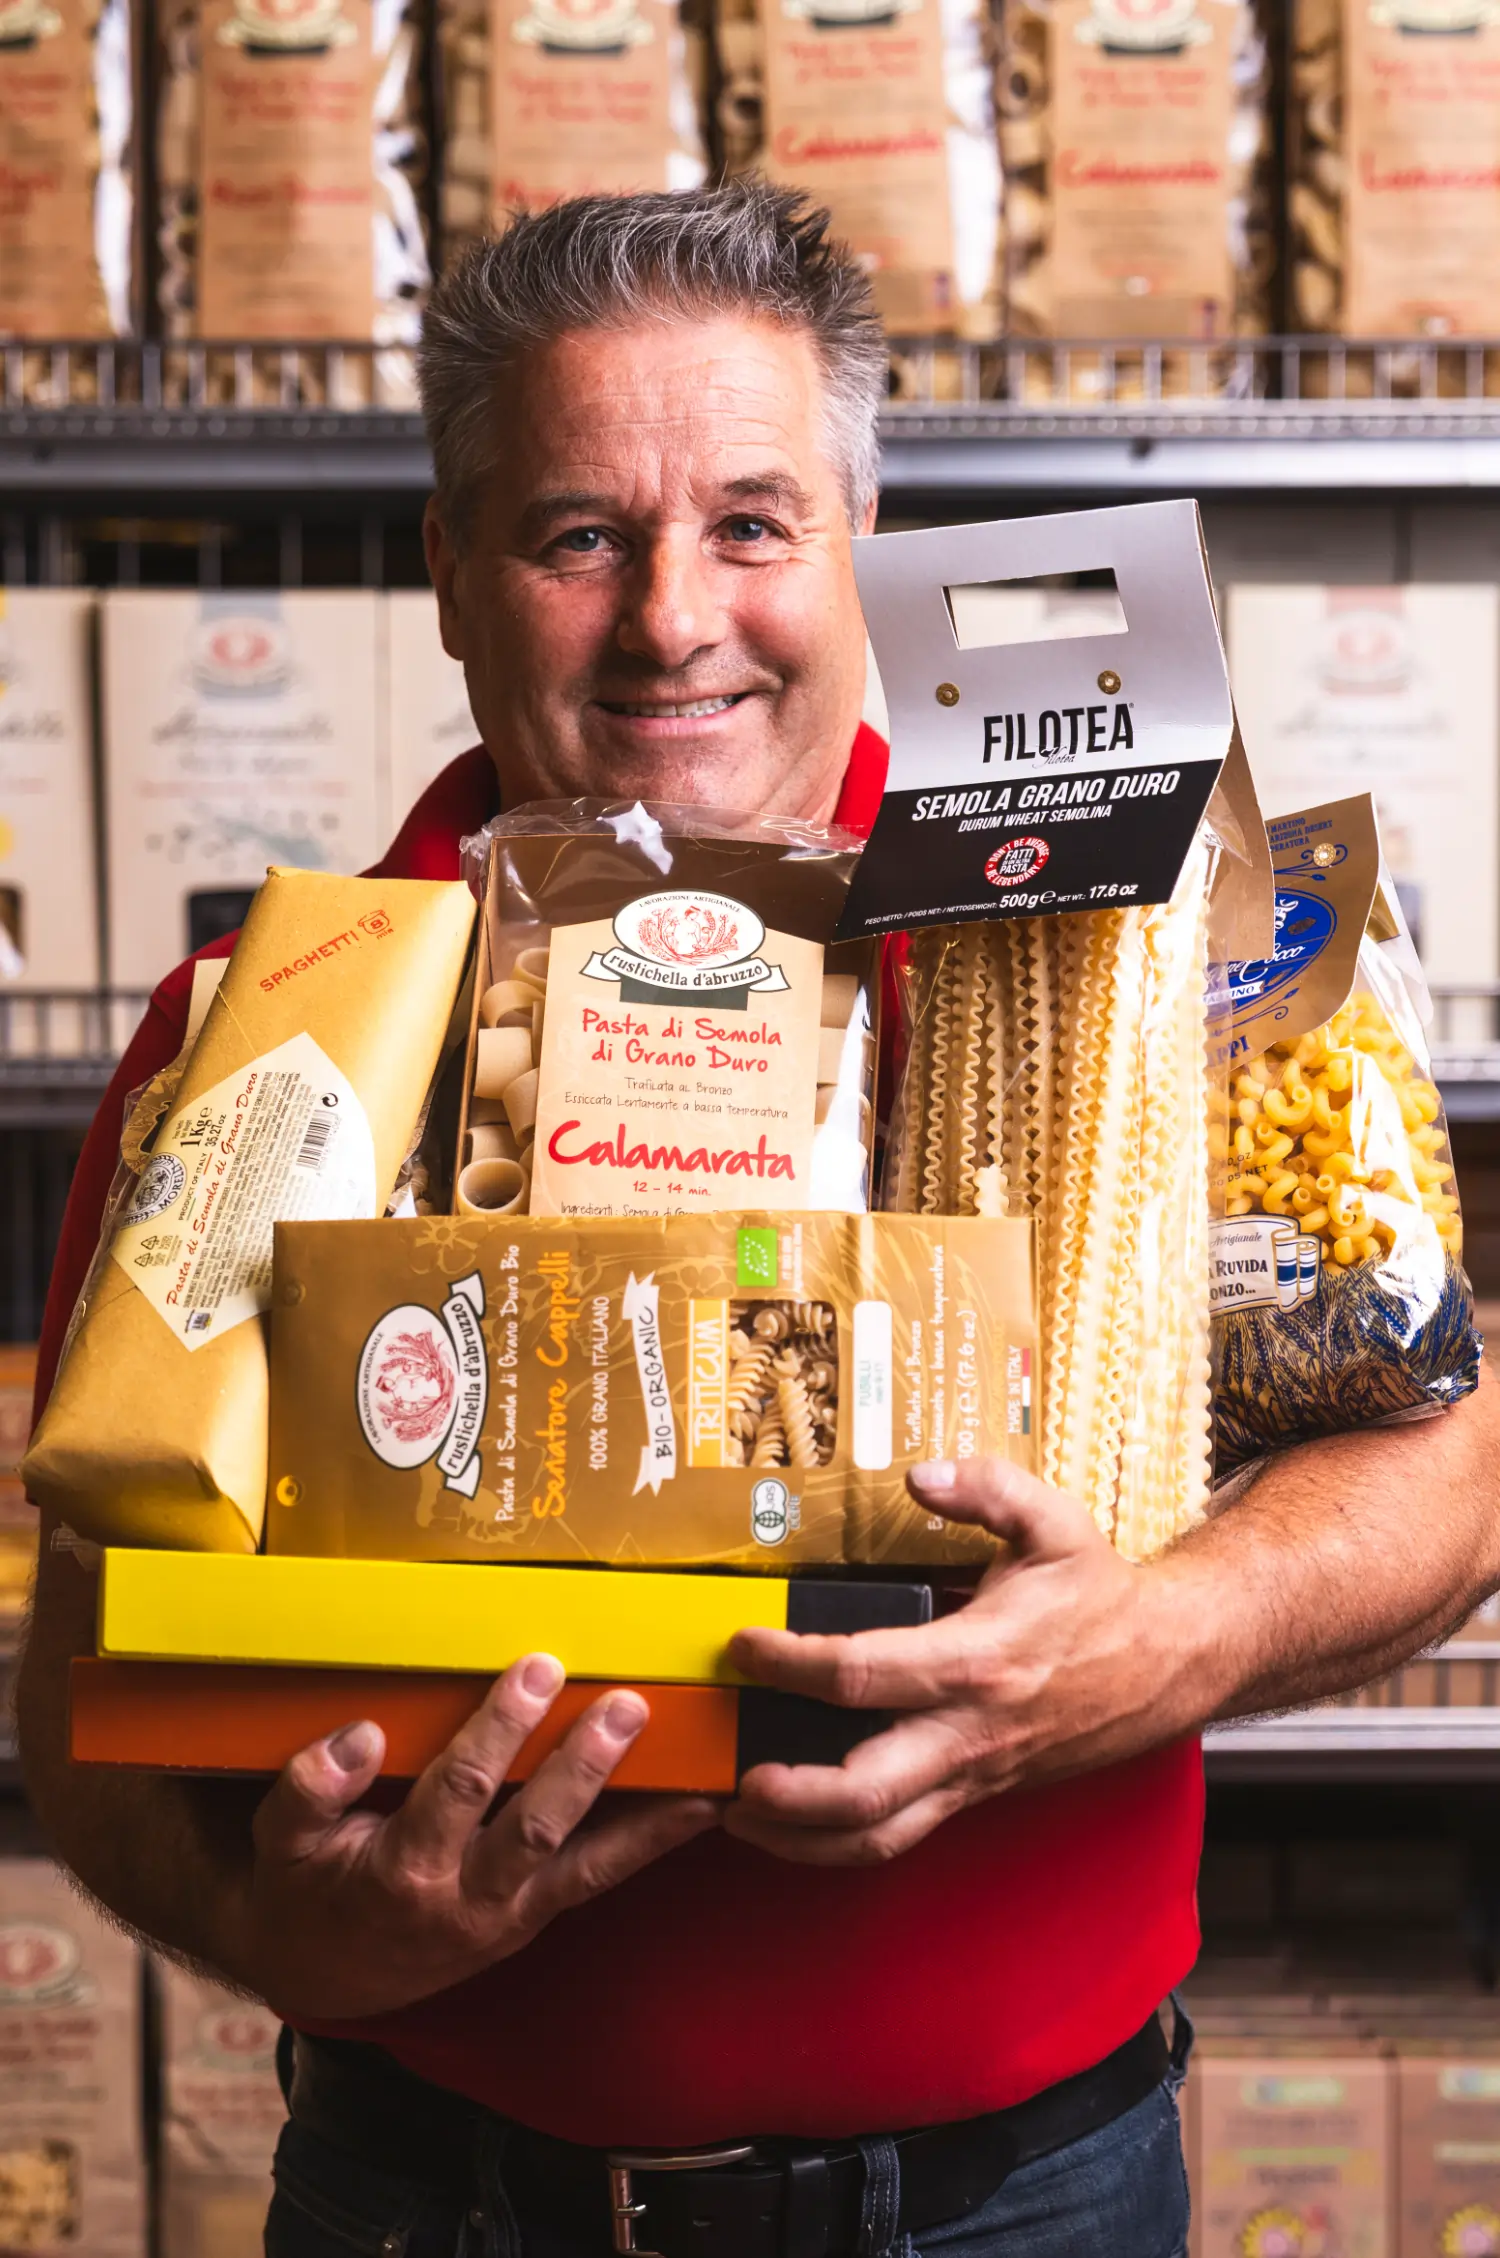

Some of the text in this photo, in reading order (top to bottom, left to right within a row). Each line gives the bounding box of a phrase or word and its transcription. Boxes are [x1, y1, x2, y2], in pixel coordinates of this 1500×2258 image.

[983, 703, 1134, 763] FILOTEA
[912, 770, 1181, 821] SEMOLA GRANO DURO
[958, 804, 1113, 833] DURUM WHEAT SEMOLINA
[989, 843, 1011, 862] DON'T
[1014, 838, 1026, 848] BE
[999, 863, 1028, 874] PASTA
[1005, 848, 1035, 861] FATTI
[992, 864, 1040, 886] LEGENDARY
[639, 895, 741, 913] LAVORAZIONE ARTIGIANALE
[865, 917, 881, 925] PESO
[1057, 894, 1070, 902] NET
[1090, 884, 1118, 899] 17.6
[1119, 884, 1139, 896] oz
[370, 919, 384, 929] 8
[376, 928, 394, 940] min
[260, 930, 360, 992] SPAGHETTI
[609, 955, 763, 986] rustichella d'abruzzo
[582, 1008, 782, 1046] Pasta di Semola
[591, 1038, 768, 1072] di Grano Duro
[564, 1092, 789, 1120] Essiccata Lentamente a bassa temperatura
[696, 1081, 733, 1096] Bronzo
[205, 1114, 227, 1147] 35.27 oz
[548, 1119, 796, 1180] Calamarata
[160, 1163, 185, 1210] MORELLI
[166, 1073, 258, 1305] Pasta di Semola di Grano Duro
[179, 1153, 207, 1221] PRODUCT OF ITALY
[632, 1181, 648, 1193] 12
[667, 1182, 683, 1194] 14
[689, 1186, 711, 1196] min.
[1215, 1259, 1268, 1278] RUVIDA
[1209, 1282, 1256, 1301] ONZO...
[956, 1309, 977, 1340] oz)
[929, 1245, 949, 1461] entamente a bassa temperatura
[956, 1342, 977, 1387] (17.6
[363, 1332, 385, 1444] LAVORAZIONE ARTIGIANALE
[447, 1303, 481, 1469] rustichella d'abruzzo
[495, 1244, 520, 1522] Pasta di Semola di Grano Duro Bio
[532, 1252, 581, 1519] Senatore Cappelli
[589, 1296, 610, 1471] 100% GRANO ITALIANO
[693, 1318, 721, 1448] TRITICUM
[904, 1320, 921, 1452] Trafilata al Bronzo
[1007, 1345, 1021, 1434] MADE IN ITALY
[964, 1417, 980, 1427] g
